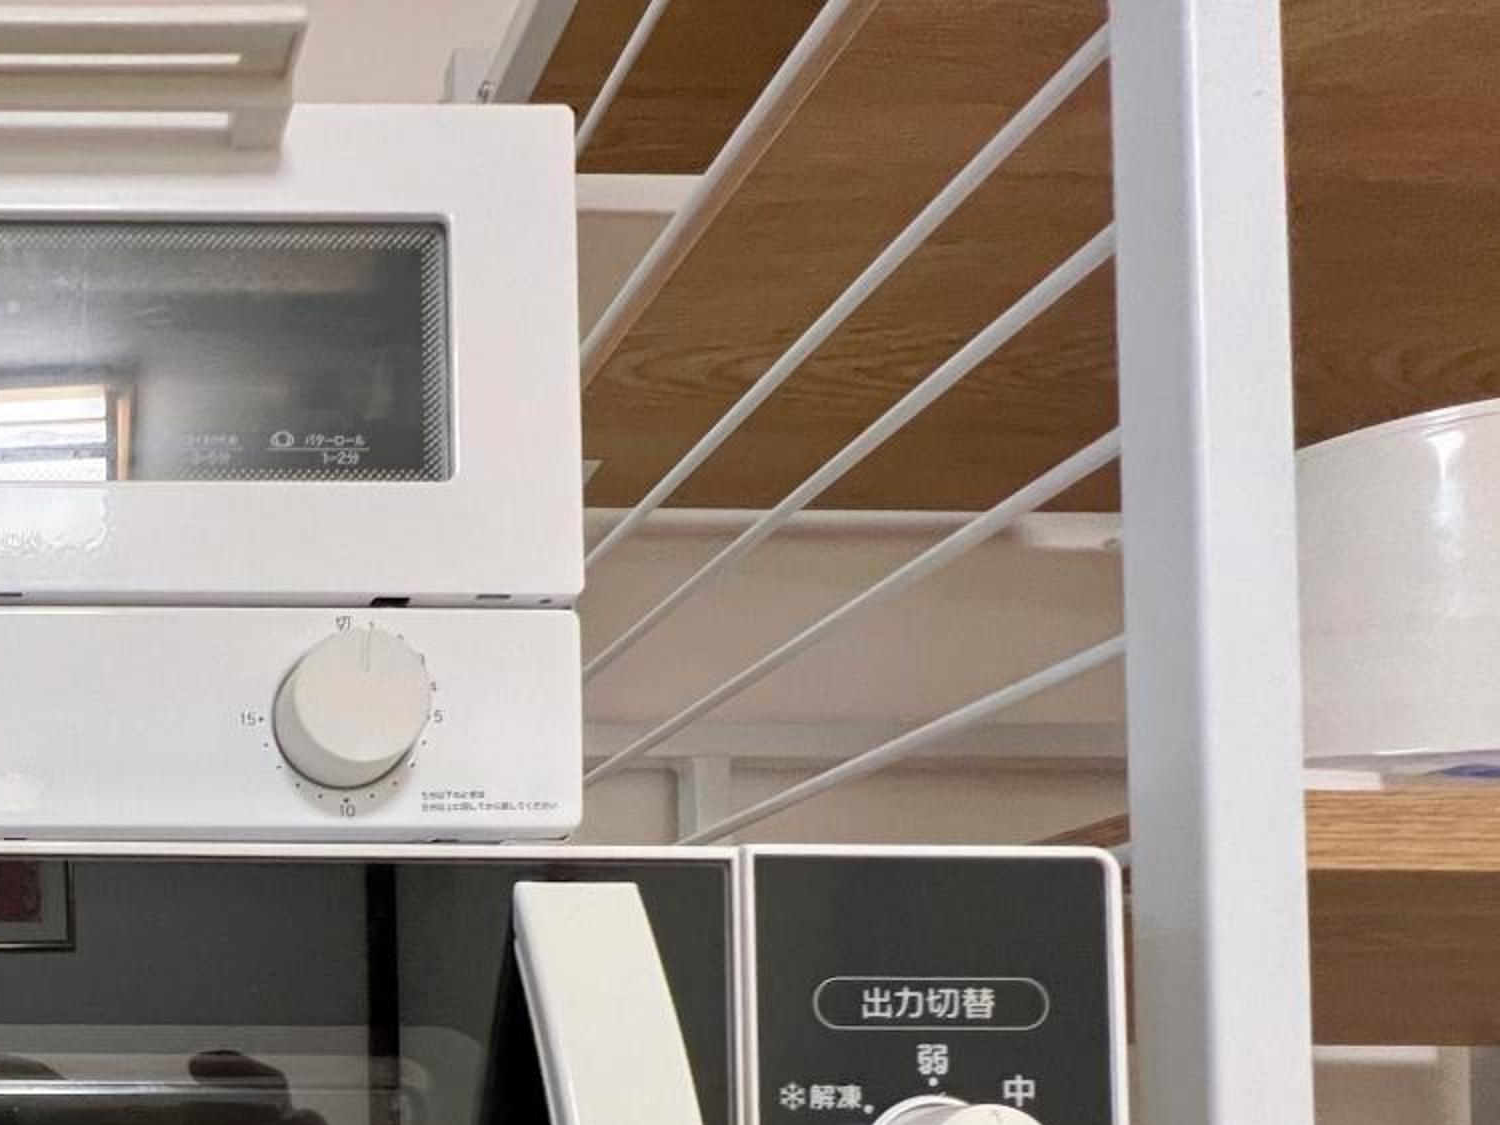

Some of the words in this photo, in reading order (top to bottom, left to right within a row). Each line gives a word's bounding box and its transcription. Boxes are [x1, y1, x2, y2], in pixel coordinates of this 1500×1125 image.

[240, 712, 257, 726] 15
[434, 709, 444, 722] 5
[340, 804, 356, 818] 10
[861, 987, 996, 1020] 出力切替
[916, 1043, 949, 1076] 弱
[809, 1084, 863, 1110] 解凍
[1002, 1074, 1036, 1108] 中
